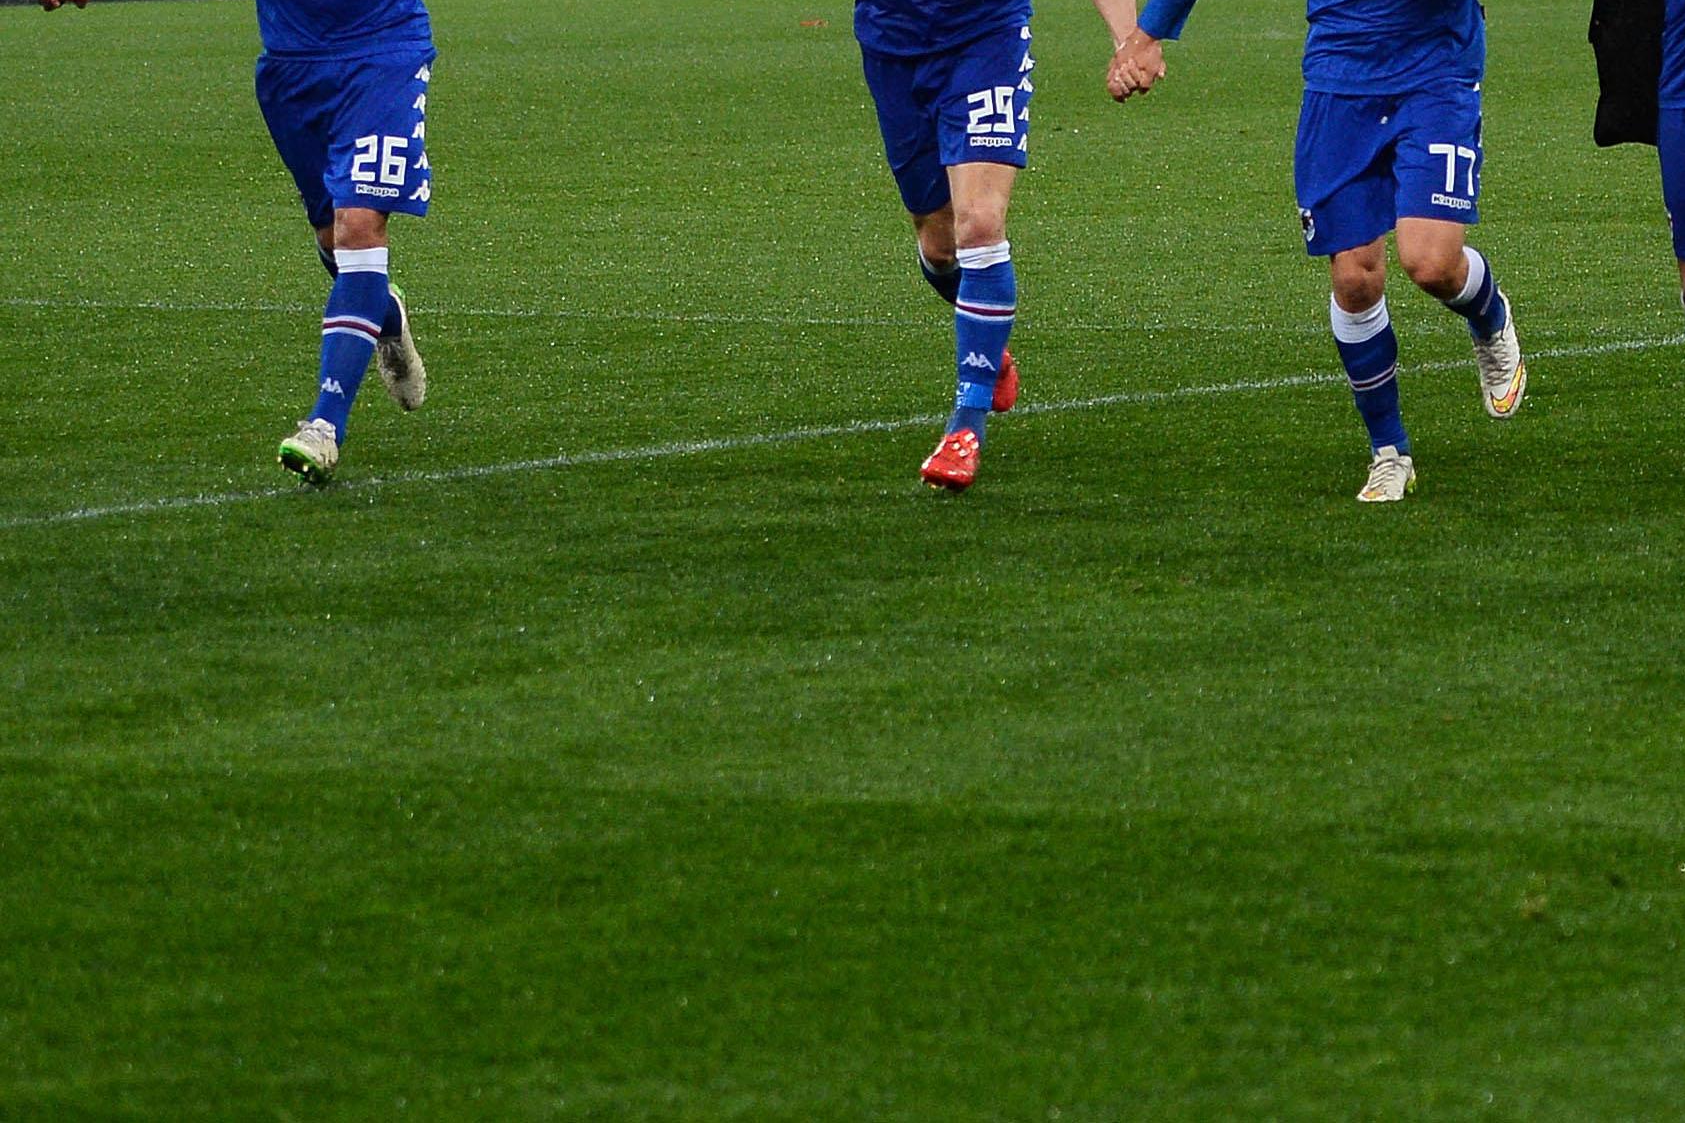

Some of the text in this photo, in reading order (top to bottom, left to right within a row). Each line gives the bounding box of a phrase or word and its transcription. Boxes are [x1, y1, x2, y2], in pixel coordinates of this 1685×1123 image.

[966, 86, 1016, 134] 29
[351, 134, 408, 186] 26
[1428, 143, 1477, 197] 77
[355, 183, 400, 198] Kappa
